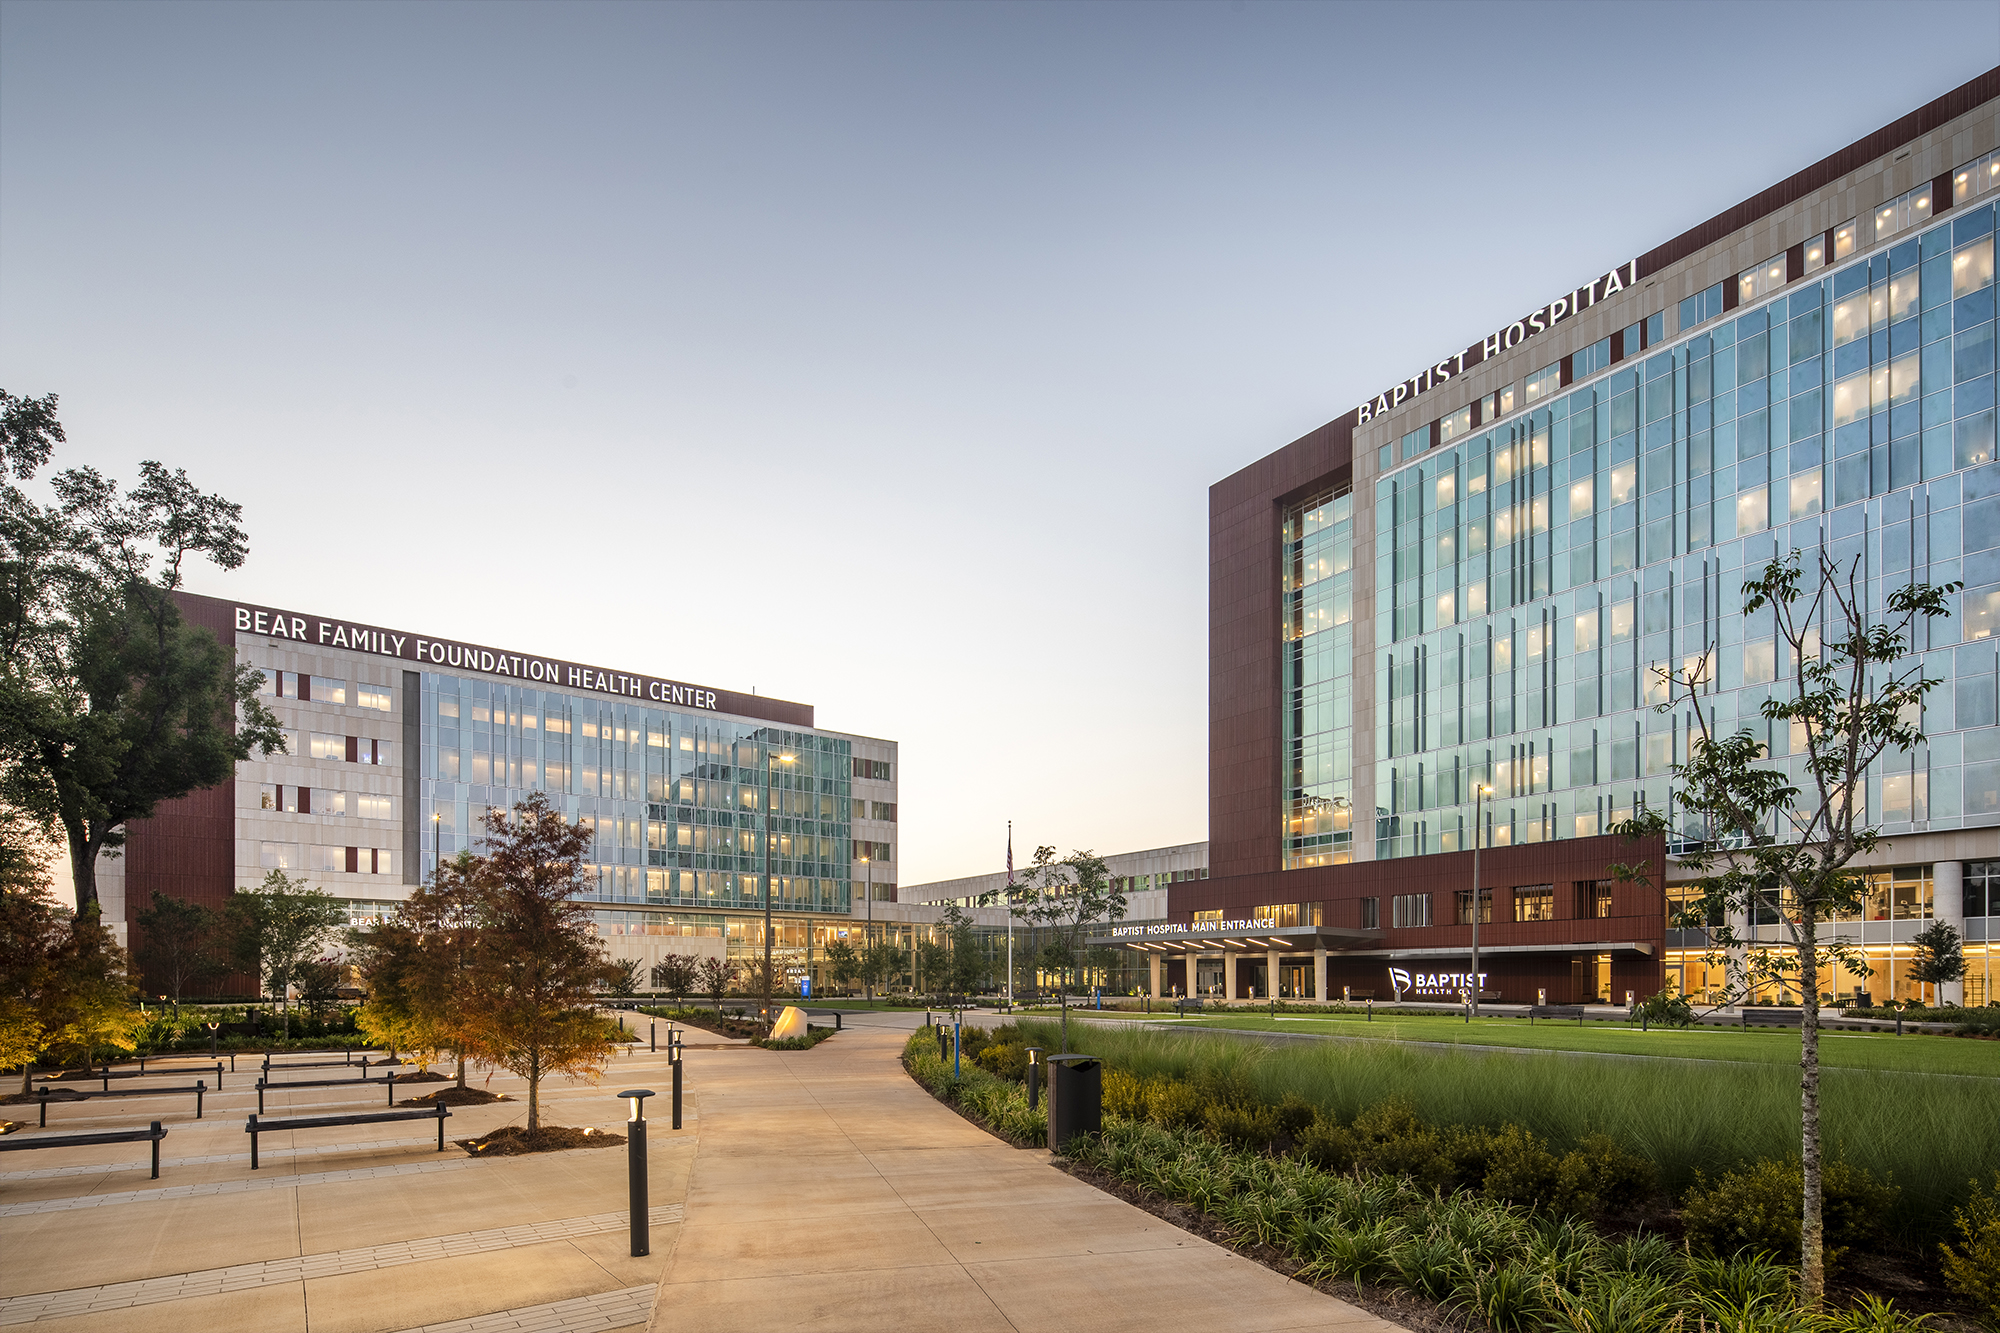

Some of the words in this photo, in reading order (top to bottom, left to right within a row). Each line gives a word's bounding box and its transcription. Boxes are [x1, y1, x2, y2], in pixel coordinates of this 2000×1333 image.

[1358, 349, 1468, 426] BAPTIST
[235, 607, 307, 640] BEAR
[319, 622, 406, 657] FAMILY
[416, 640, 559, 684] FOUNDATION
[568, 666, 641, 697] HEALTH
[649, 681, 717, 711] CENTER
[351, 917, 380, 927] BEAR
[1112, 926, 1144, 937] BAPTIST
[1147, 923, 1188, 935] HOSPITAL
[1191, 921, 1216, 932] MAIN
[1220, 918, 1275, 930] ENTRANCE
[1415, 973, 1487, 987] BAPTIST
